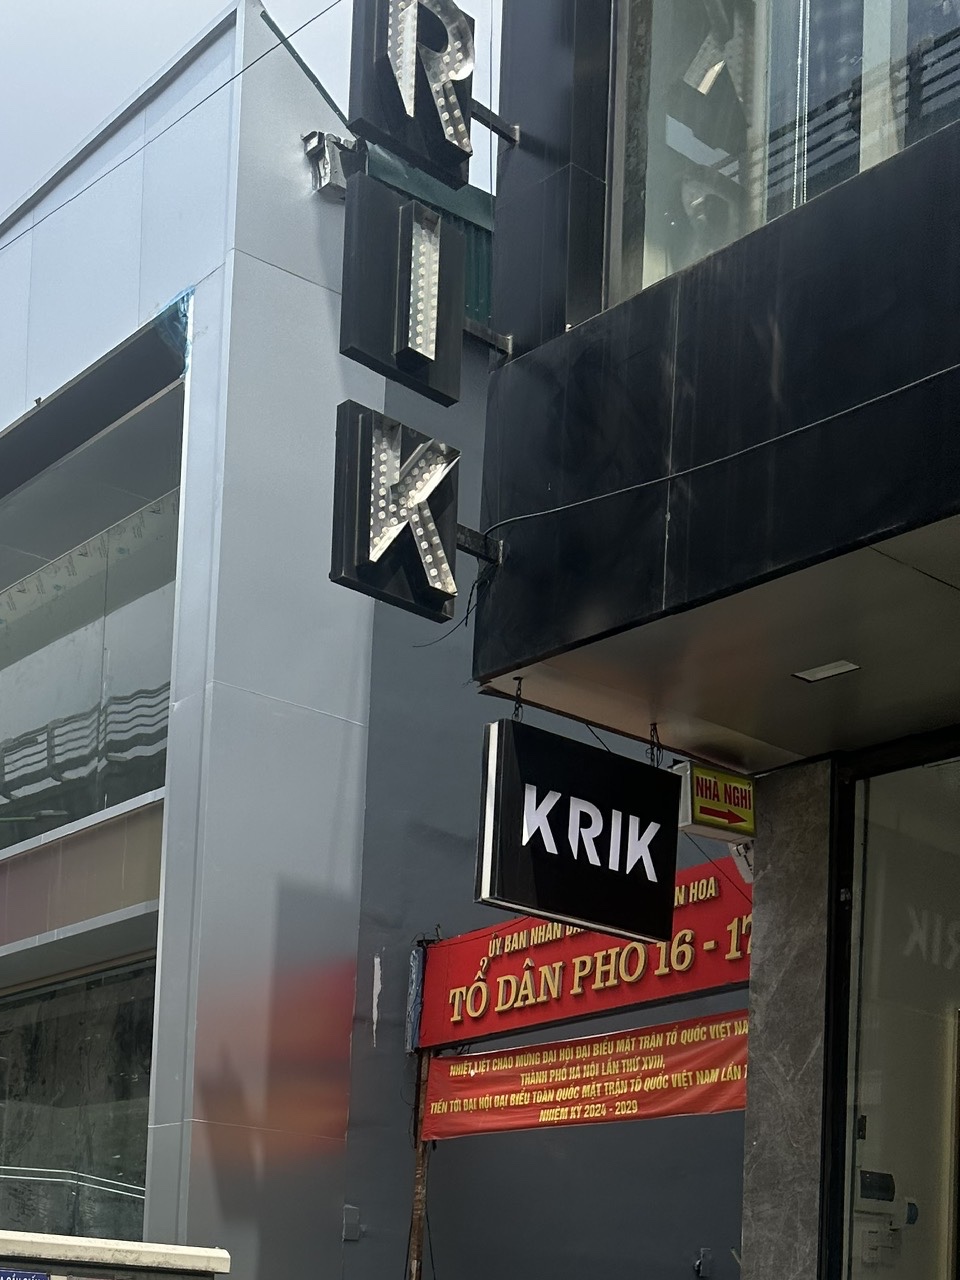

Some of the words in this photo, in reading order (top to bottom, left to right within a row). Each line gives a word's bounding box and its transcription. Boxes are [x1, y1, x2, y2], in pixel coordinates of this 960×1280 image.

[695, 775, 720, 802] NHÀ
[724, 782, 752, 811] NGHỈ
[522, 783, 661, 882] KRIK
[504, 930, 528, 953] BAN
[448, 956, 488, 1023] TỔ
[494, 958, 564, 1012] DÂN
[654, 929, 695, 976] 16
[450, 1062, 472, 1078] NHIỆT
[474, 1059, 490, 1073] LIỆT
[542, 1050, 557, 1066] ĐẠI
[559, 1045, 574, 1063] HỘI
[576, 1045, 590, 1062] ĐẠI
[639, 1033, 663, 1051] TRẬN
[680, 1023, 707, 1044] QUỐC
[709, 1022, 731, 1042] VIỆT
[430, 1097, 447, 1114] TIẾN
[463, 1097, 477, 1113] ĐẠI
[478, 1094, 493, 1113] HỘI
[494, 1094, 509, 1110] ĐẠI
[556, 1083, 580, 1101] QUỐC
[604, 1079, 627, 1097] TRẬN
[643, 1071, 669, 1091] QUỐC
[671, 1071, 693, 1090] VIỆT
[696, 1068, 718, 1085] NAM
[549, 1063, 567, 1083] PHỐ
[582, 1062, 599, 1080] NỘI
[583, 1103, 607, 1118] 2024
[615, 1099, 638, 1115] 2029
